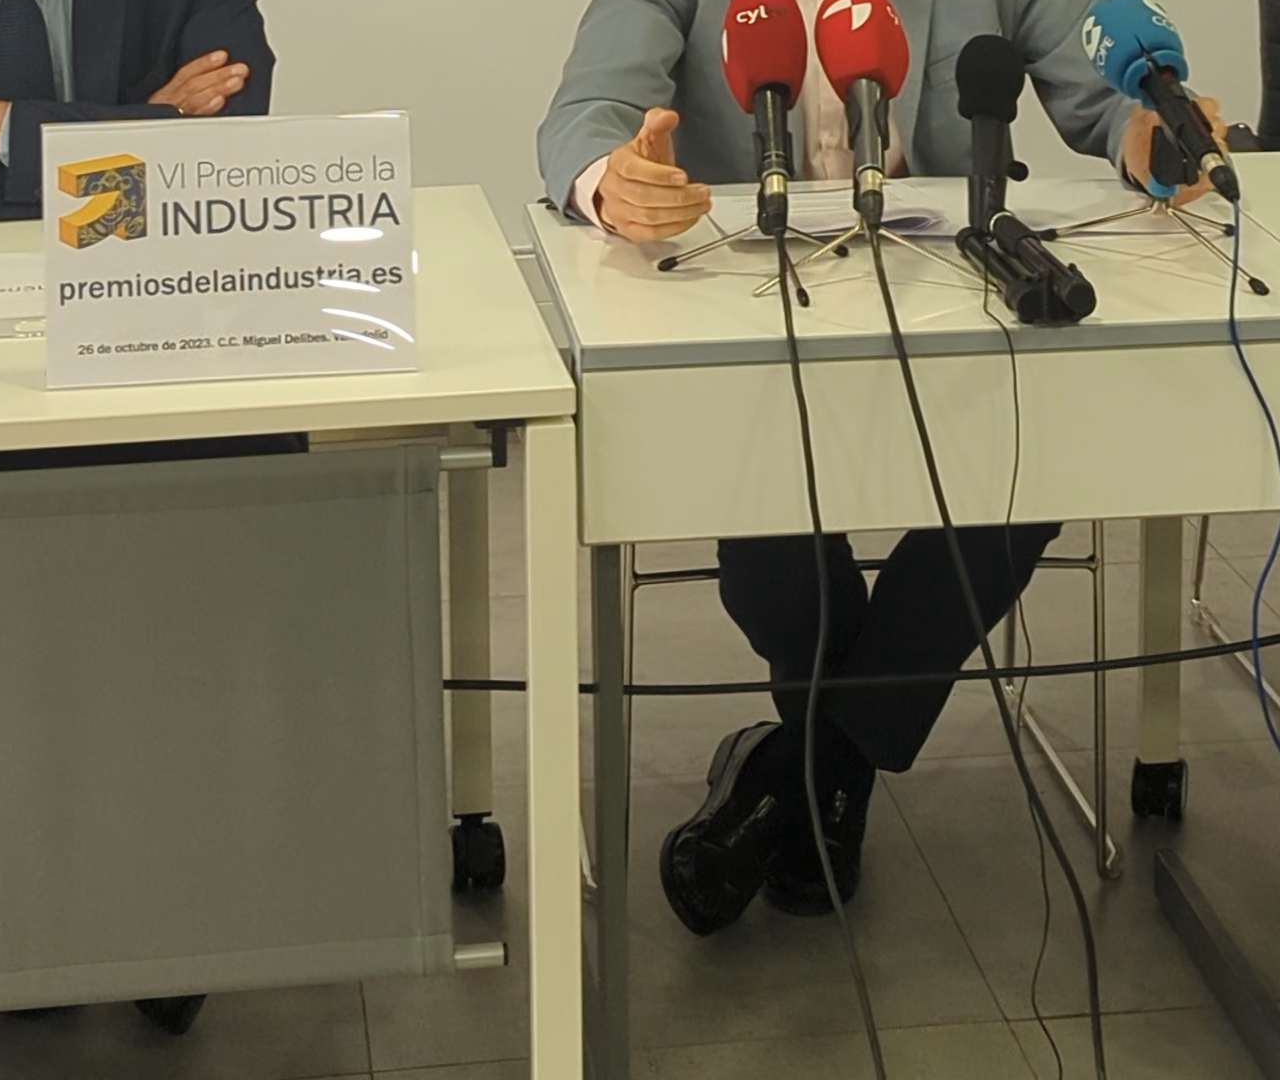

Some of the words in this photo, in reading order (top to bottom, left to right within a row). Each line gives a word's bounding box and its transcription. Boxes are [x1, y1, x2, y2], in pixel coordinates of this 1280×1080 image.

[157, 162, 185, 190] VI
[197, 158, 317, 189] Premios
[325, 155, 364, 184] de
[372, 154, 396, 182] la
[161, 191, 401, 237] INDUSTRIA
[58, 263, 404, 306] premiosdelaindustria.es
[77, 343, 94, 356] 26
[97, 343, 112, 354] de
[114, 341, 159, 353] octubre
[161, 340, 177, 351] de
[242, 333, 281, 348] Miguel
